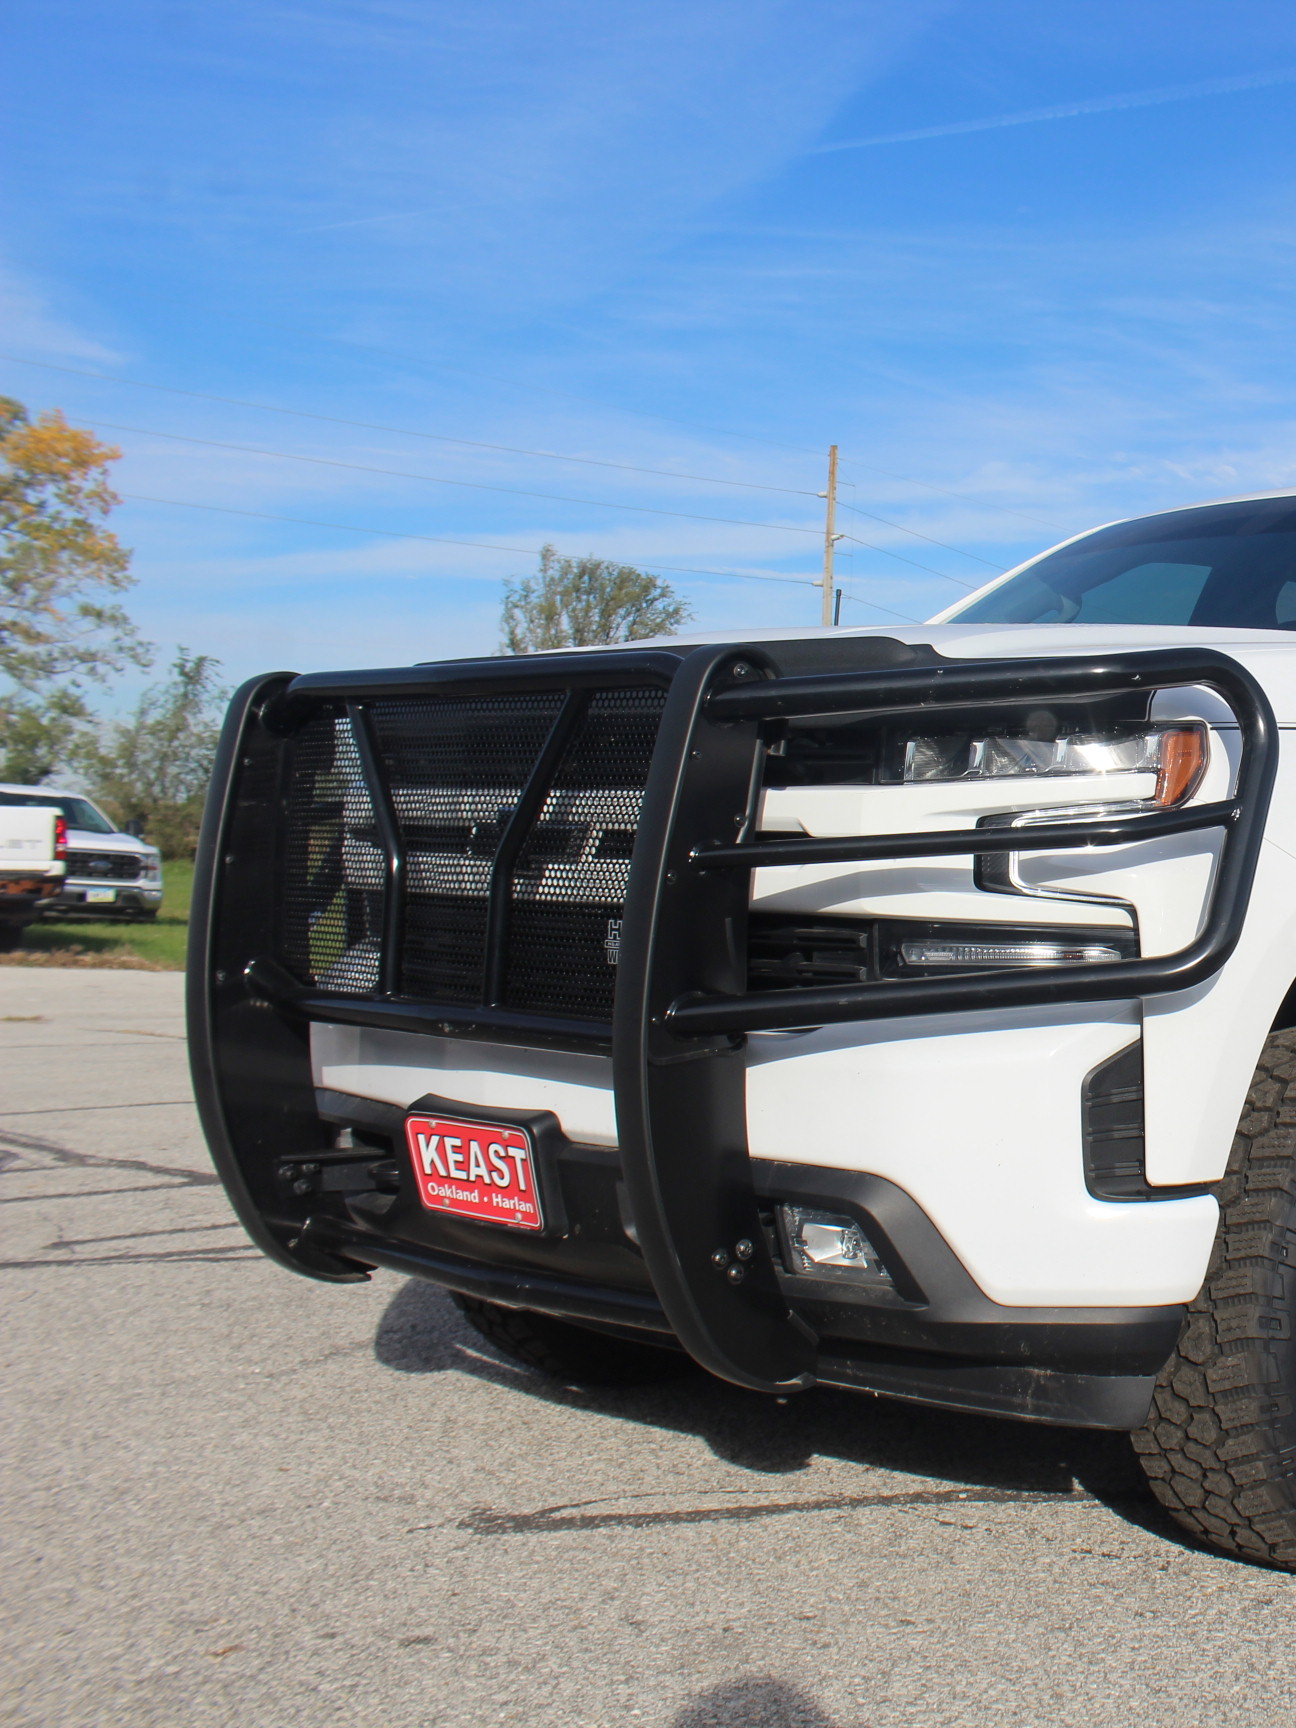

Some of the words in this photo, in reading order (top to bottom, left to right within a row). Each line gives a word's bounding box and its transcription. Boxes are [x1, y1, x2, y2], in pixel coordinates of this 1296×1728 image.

[416, 1133, 527, 1191] KEAST
[427, 1182, 480, 1203] Oakland
[492, 1192, 534, 1214] Harlan
